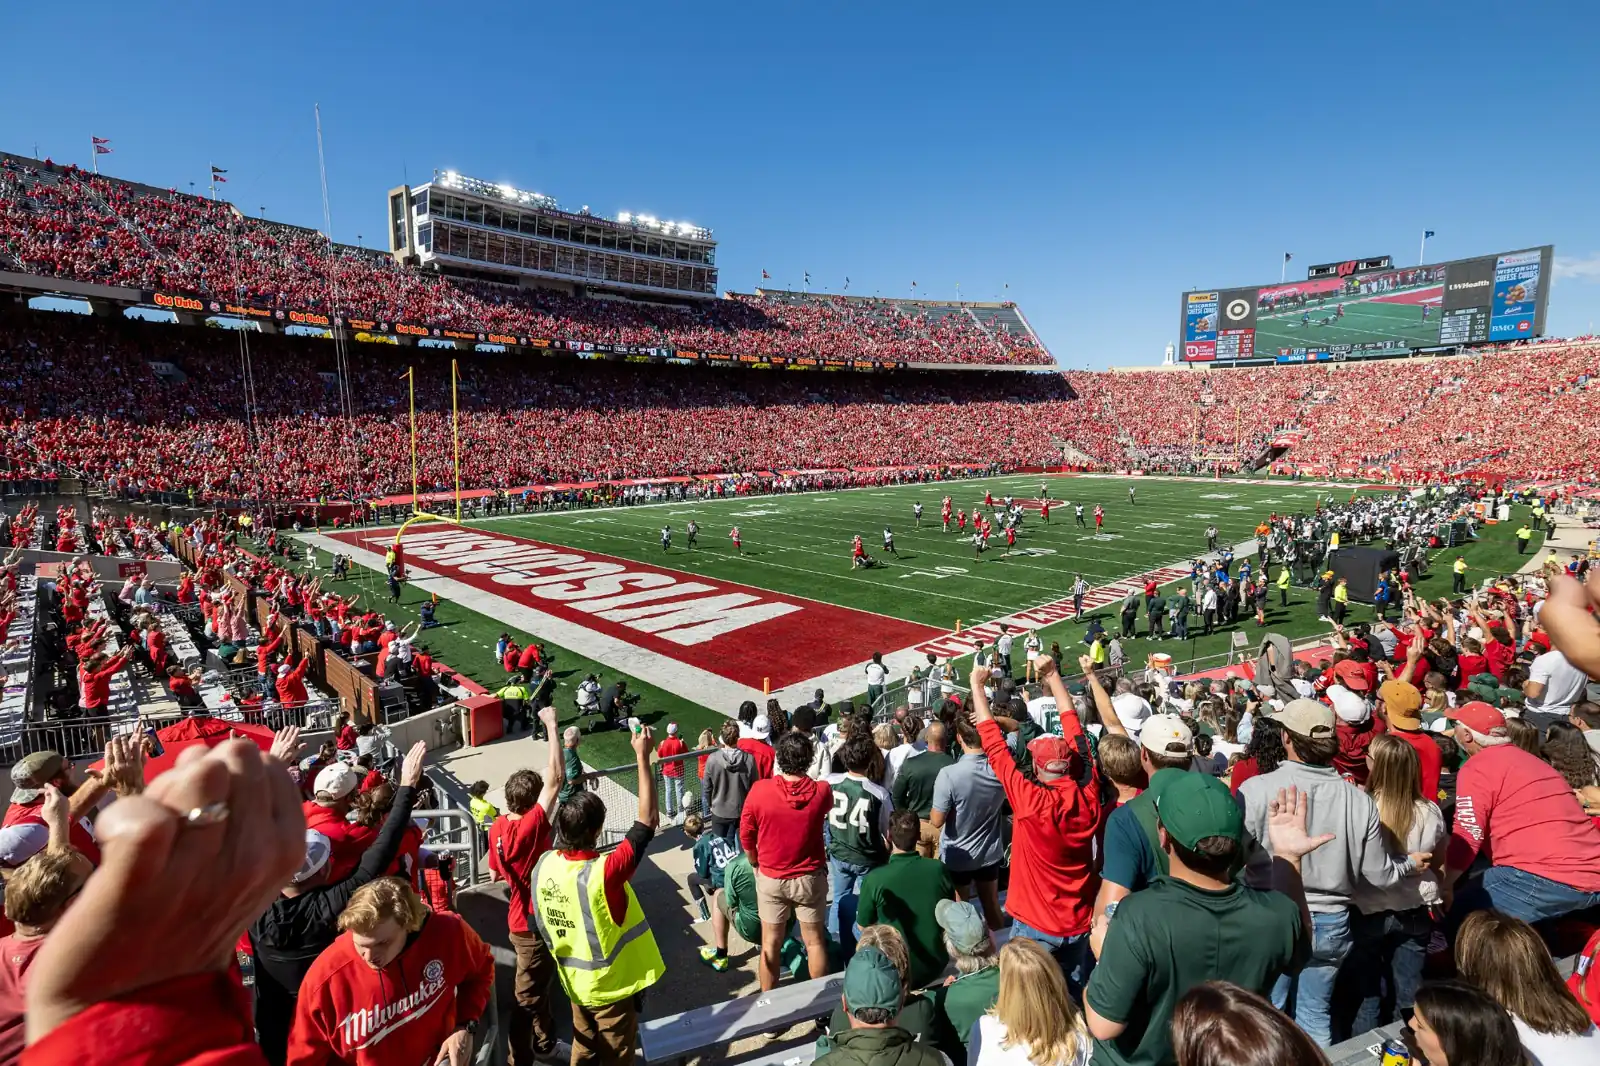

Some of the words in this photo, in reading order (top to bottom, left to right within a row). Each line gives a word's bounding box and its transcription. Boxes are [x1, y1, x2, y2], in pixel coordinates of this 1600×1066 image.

[1336, 260, 1358, 279] W
[1497, 264, 1538, 275] WISCONSIN
[1496, 273, 1517, 282] CHEESE
[154, 293, 173, 306] Old
[174, 296, 203, 310] Dutch
[289, 311, 304, 322] Old
[306, 314, 329, 325] Dutch
[396, 324, 408, 334] Old
[410, 325, 429, 336] Dutch
[1492, 323, 1515, 332] BMO
[898, 565, 970, 579] 10
[361, 529, 803, 647] WISCONSIN
[914, 622, 1030, 658] FIELD
[829, 790, 870, 834] 24
[713, 842, 736, 869] 84
[547, 906, 567, 920] GUEST
[337, 976, 446, 1046] Milwaukee
